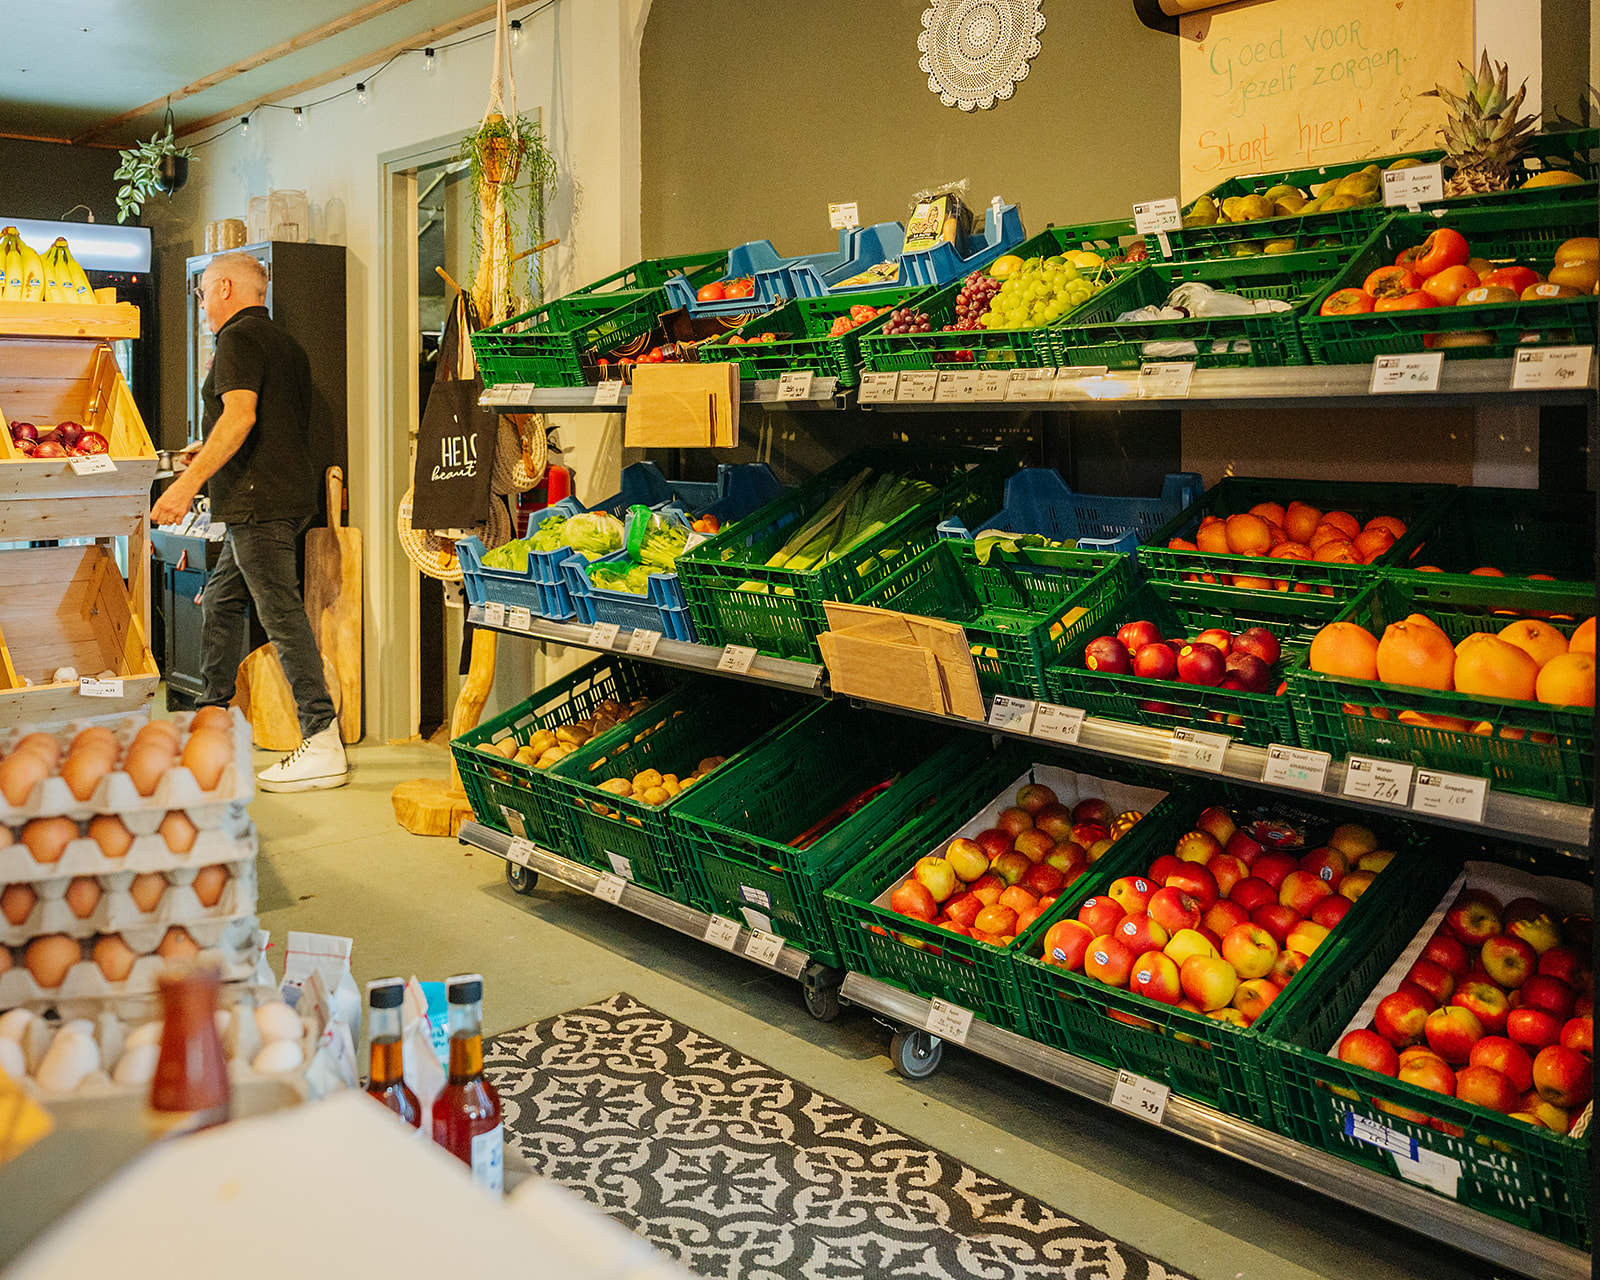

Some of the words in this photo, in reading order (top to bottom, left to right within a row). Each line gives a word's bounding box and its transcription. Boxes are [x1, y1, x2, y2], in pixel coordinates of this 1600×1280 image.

[1210, 28, 1287, 97] Goed
[1231, 64, 1297, 118] jezelf
[1192, 123, 1274, 172] Start
[1292, 752, 1309, 760] Navel
